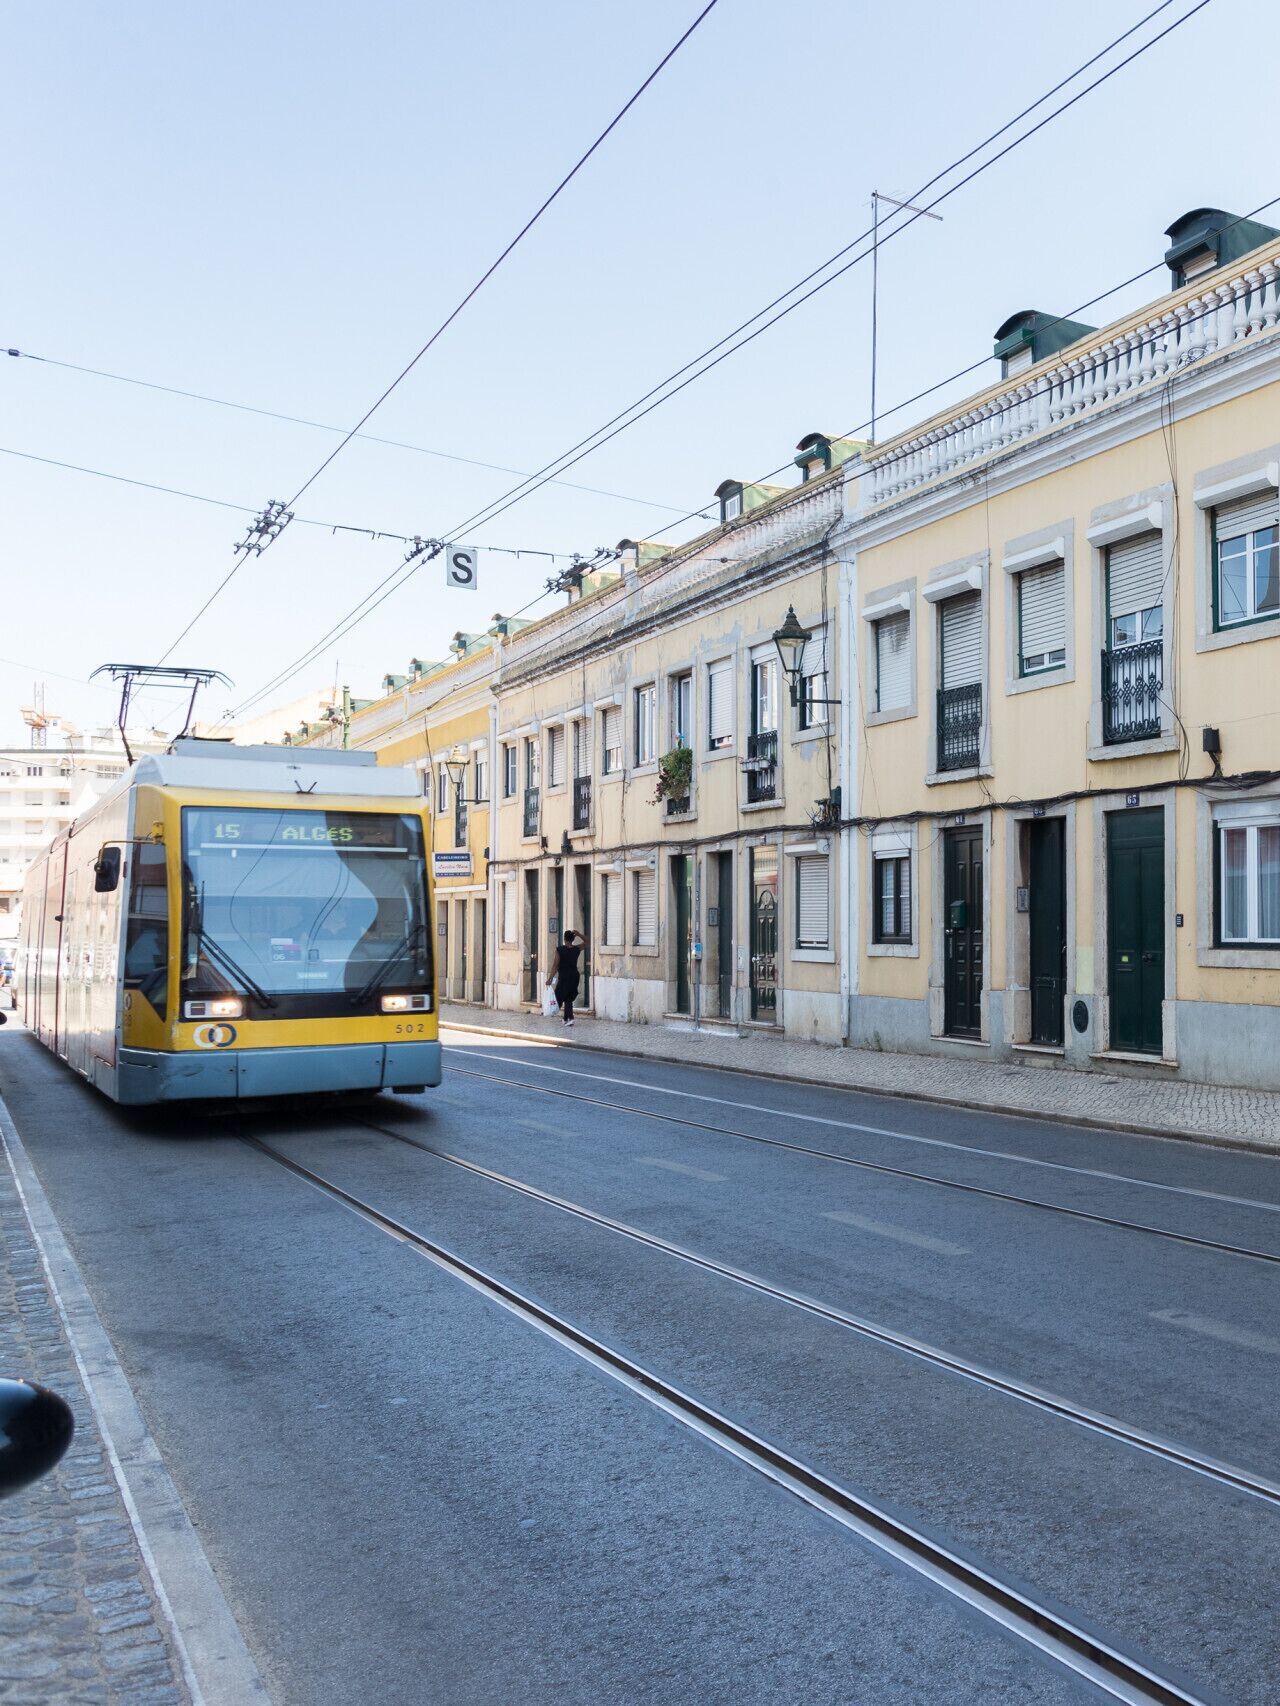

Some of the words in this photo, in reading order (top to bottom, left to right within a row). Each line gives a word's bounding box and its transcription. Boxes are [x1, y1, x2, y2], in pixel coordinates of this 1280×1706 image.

[452, 552, 473, 584] S
[215, 823, 240, 839] 15
[395, 1023, 425, 1034] 502
